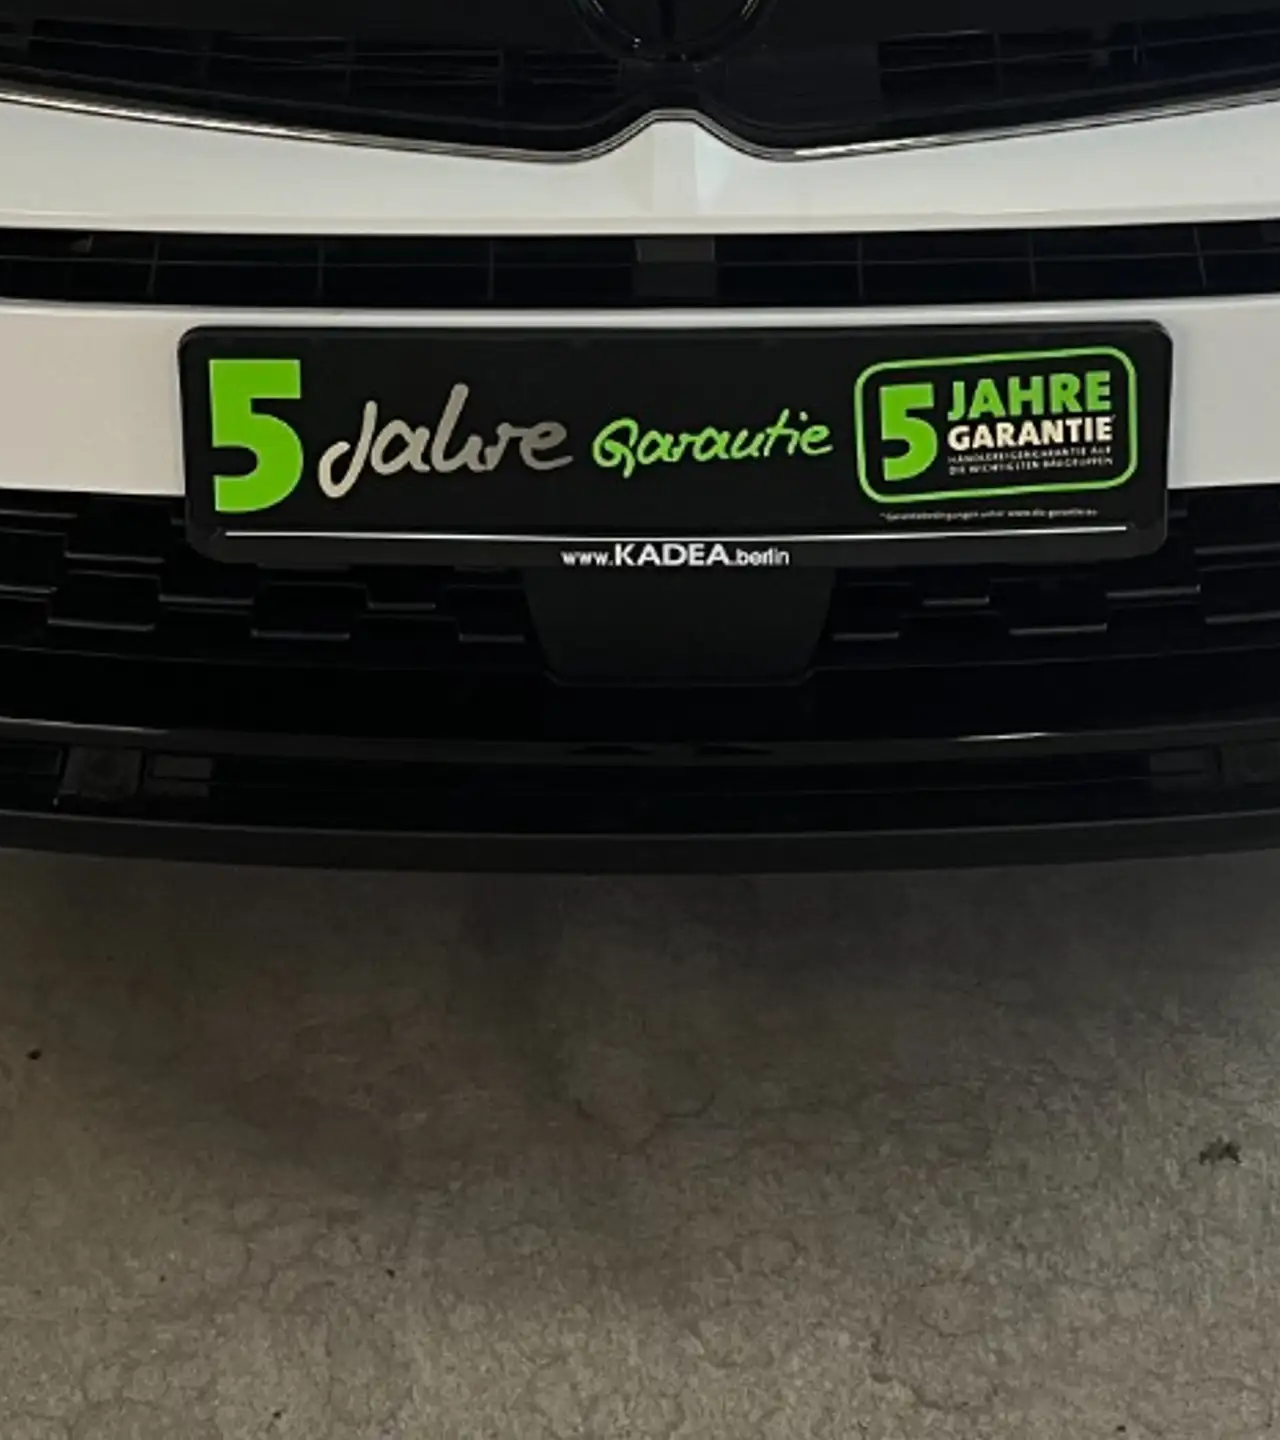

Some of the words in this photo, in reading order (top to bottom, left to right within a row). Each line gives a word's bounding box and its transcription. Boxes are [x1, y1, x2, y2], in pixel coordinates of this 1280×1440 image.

[209, 358, 304, 512] 5
[317, 382, 573, 499] Jahre
[592, 407, 834, 479] Garantie
[879, 382, 939, 482] 5
[946, 369, 1112, 422] JAHRE
[946, 415, 1114, 452] GARANTIE
[560, 542, 790, 567] www.KADEA.berlin
